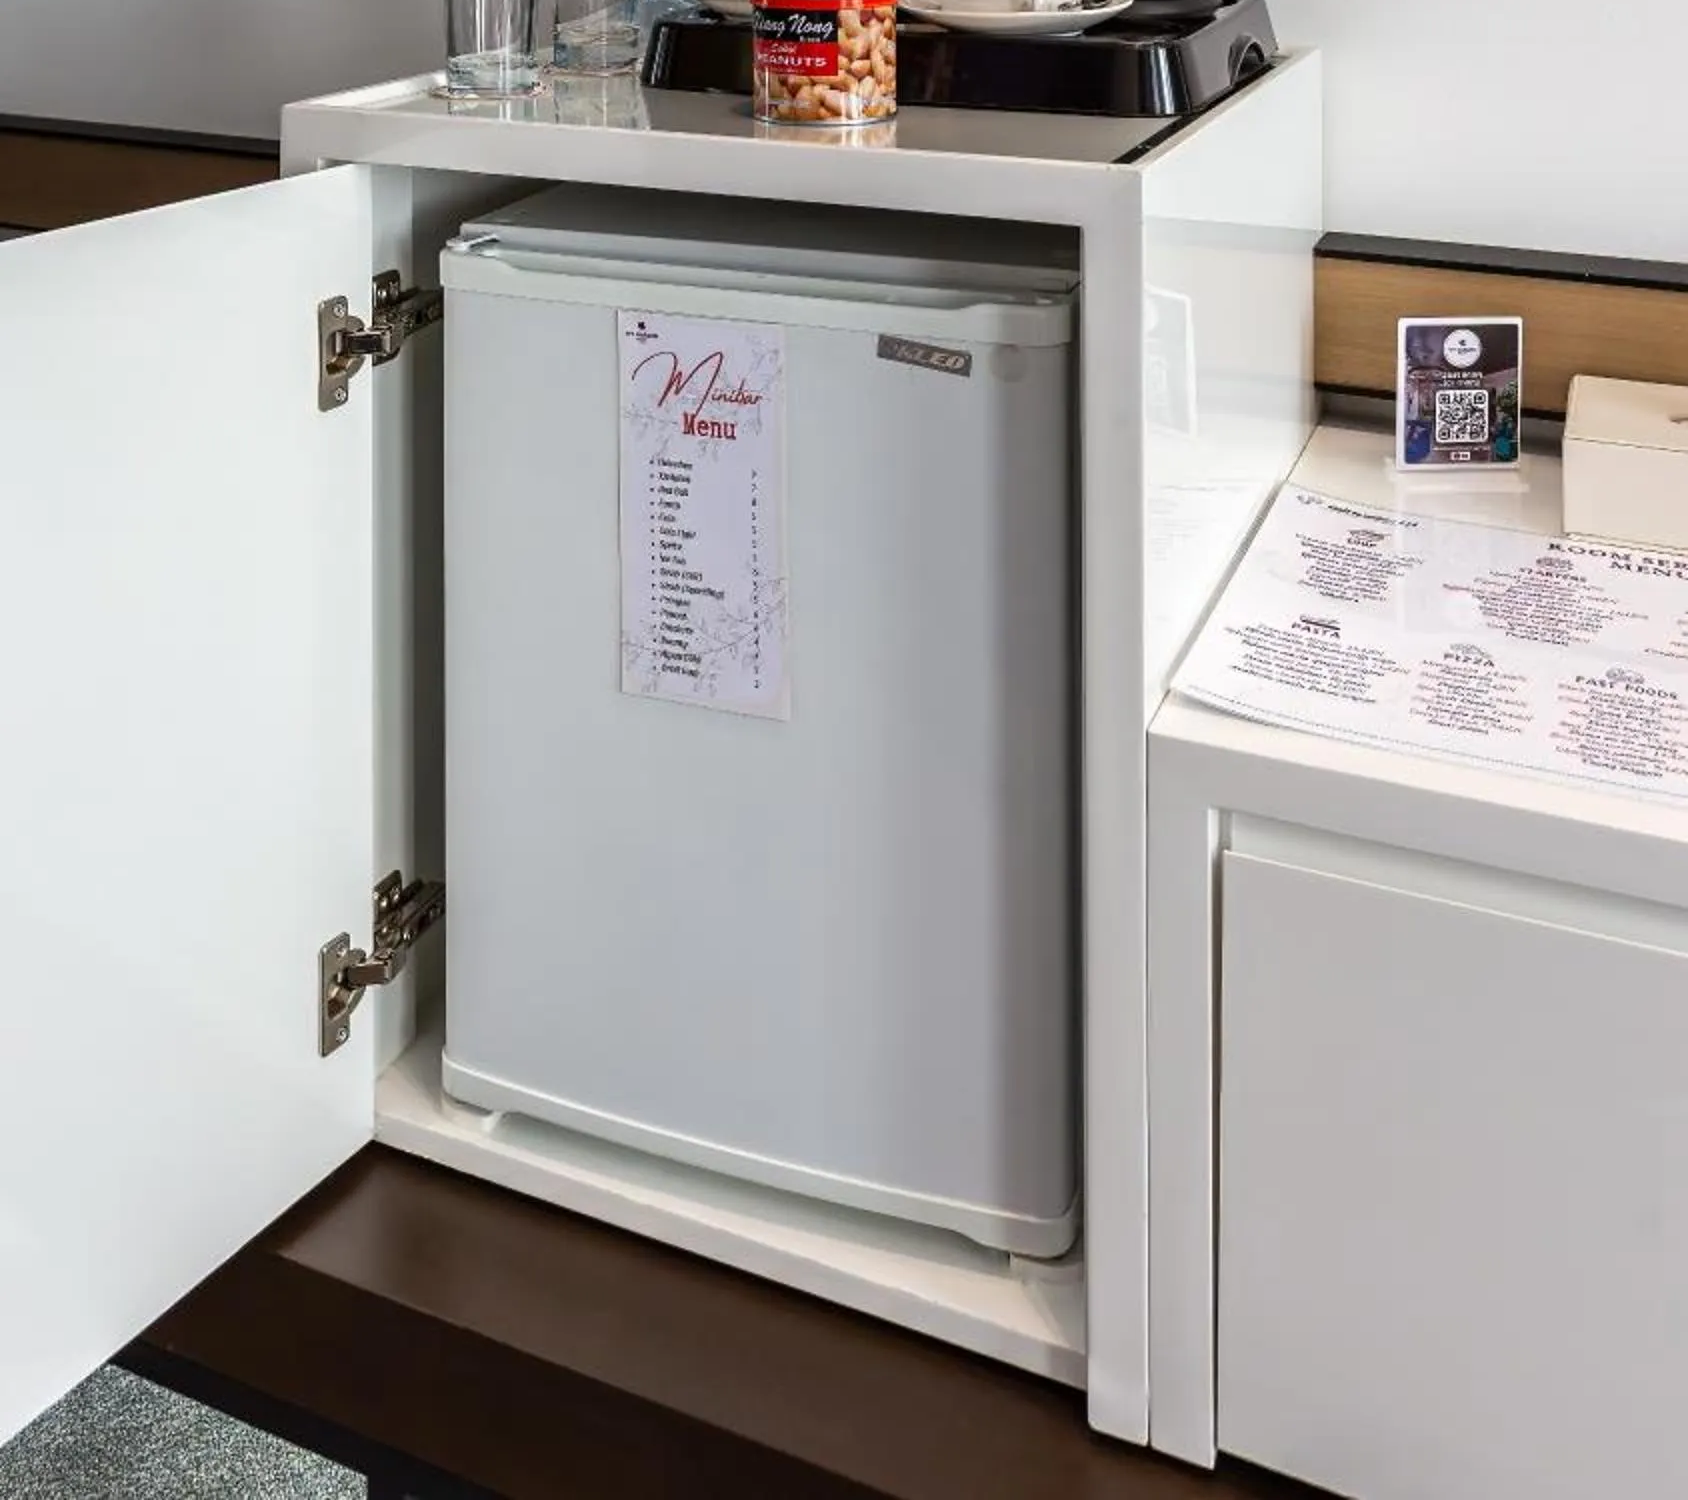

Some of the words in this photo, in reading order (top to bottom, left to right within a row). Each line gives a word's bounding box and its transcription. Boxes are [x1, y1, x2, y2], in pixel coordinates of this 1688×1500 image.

[631, 351, 763, 419] Minibar
[682, 412, 738, 441] Menu
[1548, 542, 1632, 562] ROOM
[1291, 622, 1341, 639] PASTA
[1443, 653, 1495, 667] PIZZA
[1575, 675, 1616, 689] FAST
[1625, 683, 1678, 700] FOODS
